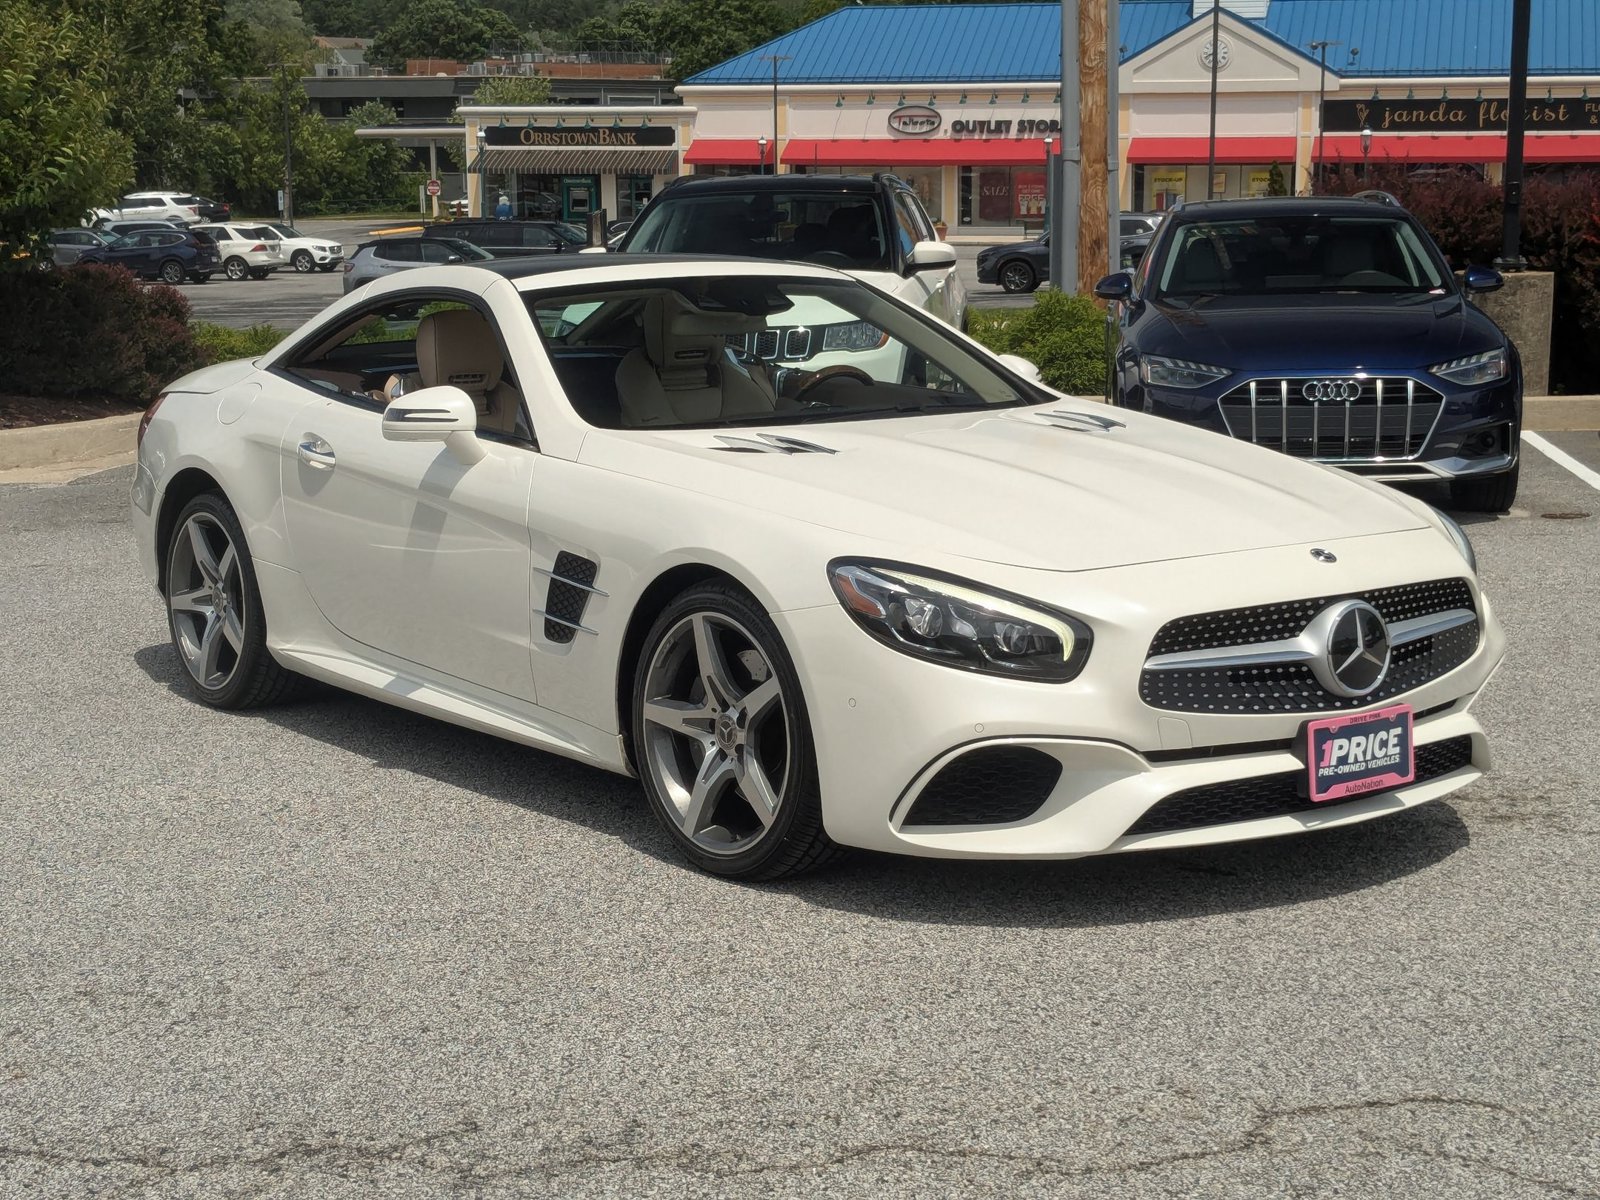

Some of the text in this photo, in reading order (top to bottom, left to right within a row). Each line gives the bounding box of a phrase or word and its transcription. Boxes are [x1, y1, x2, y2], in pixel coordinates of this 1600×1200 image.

[1381, 101, 1569, 128] janda floist
[1585, 103, 1600, 113] FL
[1589, 114, 1598, 125] &
[951, 119, 1062, 134] OUTLET STOR
[982, 185, 1009, 196] SALE
[1349, 715, 1367, 724] DRIVE
[1318, 755, 1400, 777] PRE-OWNED VEHICLES
[1344, 779, 1384, 794] AutoNation
